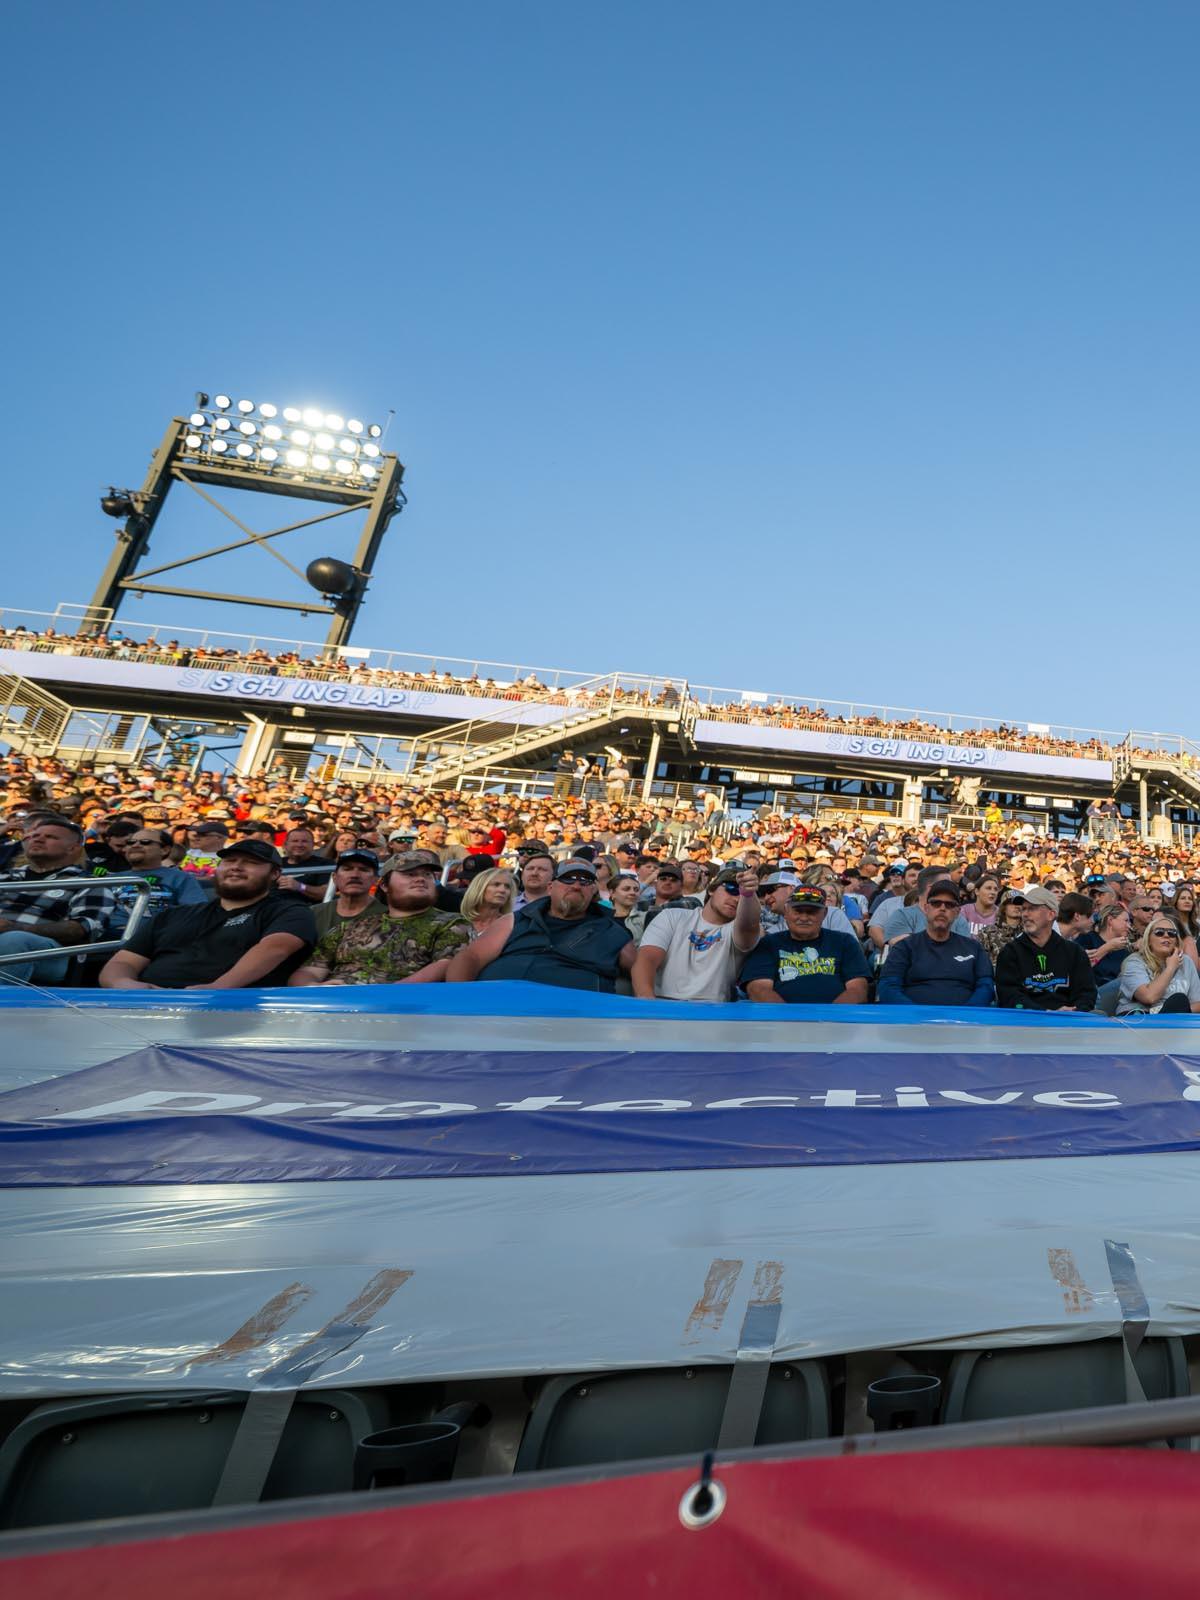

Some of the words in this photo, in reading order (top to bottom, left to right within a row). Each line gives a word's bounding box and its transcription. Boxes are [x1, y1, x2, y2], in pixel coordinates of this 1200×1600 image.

[348, 688, 406, 708] LAP
[947, 749, 985, 765] LAP
[33, 1087, 1124, 1120] Protective
